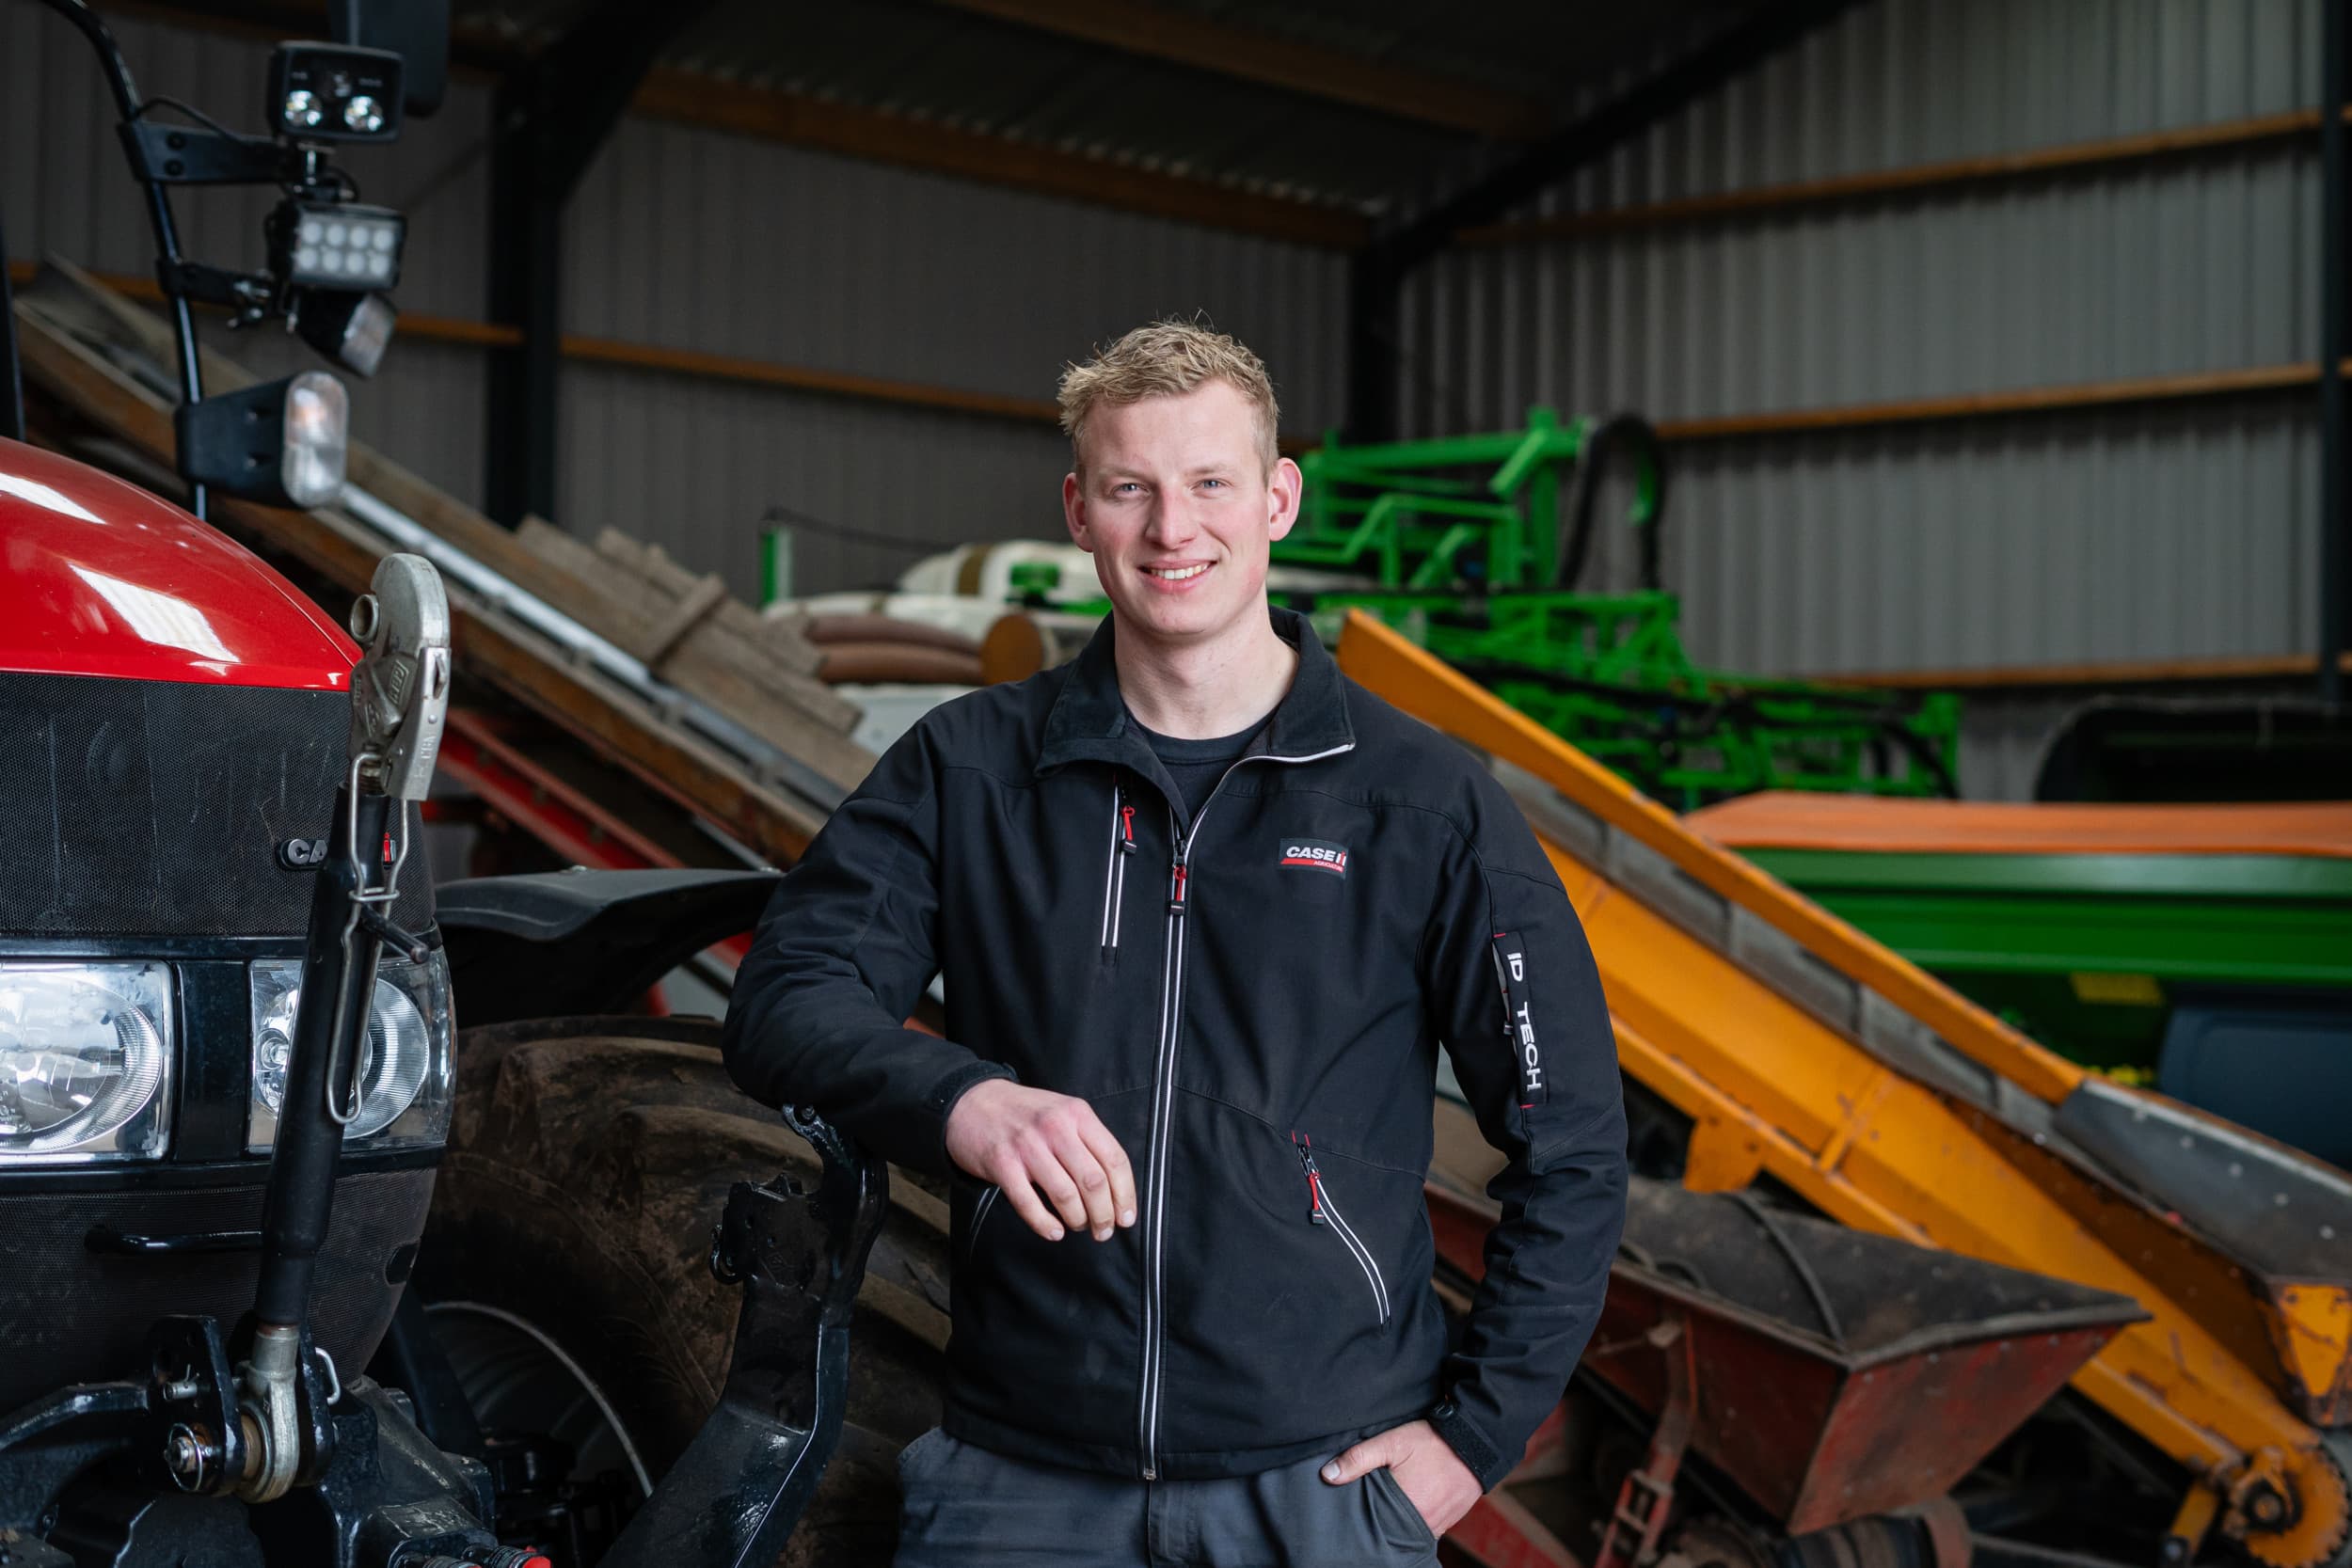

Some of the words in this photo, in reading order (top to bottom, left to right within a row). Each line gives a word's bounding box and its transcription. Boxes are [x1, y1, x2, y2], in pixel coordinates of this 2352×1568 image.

[1286, 846, 1336, 862] CASE
[1507, 952, 1523, 982] ID
[1517, 1001, 1542, 1091] TECH
